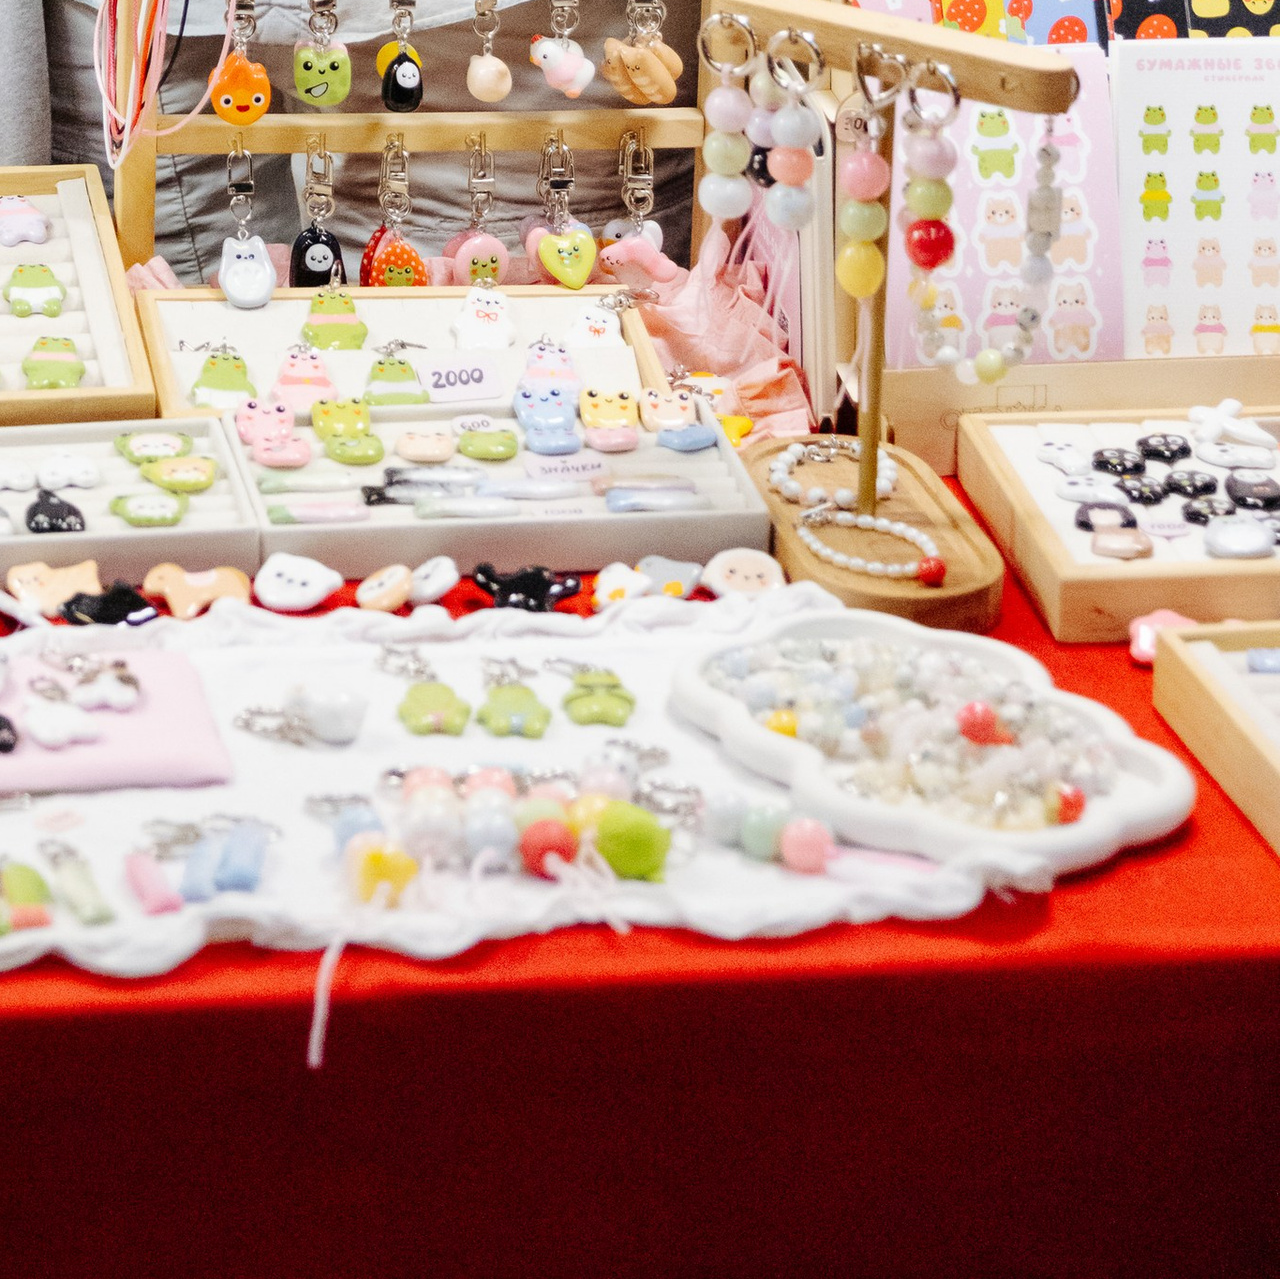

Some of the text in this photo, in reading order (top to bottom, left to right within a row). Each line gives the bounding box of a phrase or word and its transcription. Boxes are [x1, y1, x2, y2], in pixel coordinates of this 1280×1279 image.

[1135, 57, 1280, 72] БУМАЖНЫЕ ЗВ
[431, 368, 484, 389] 2000
